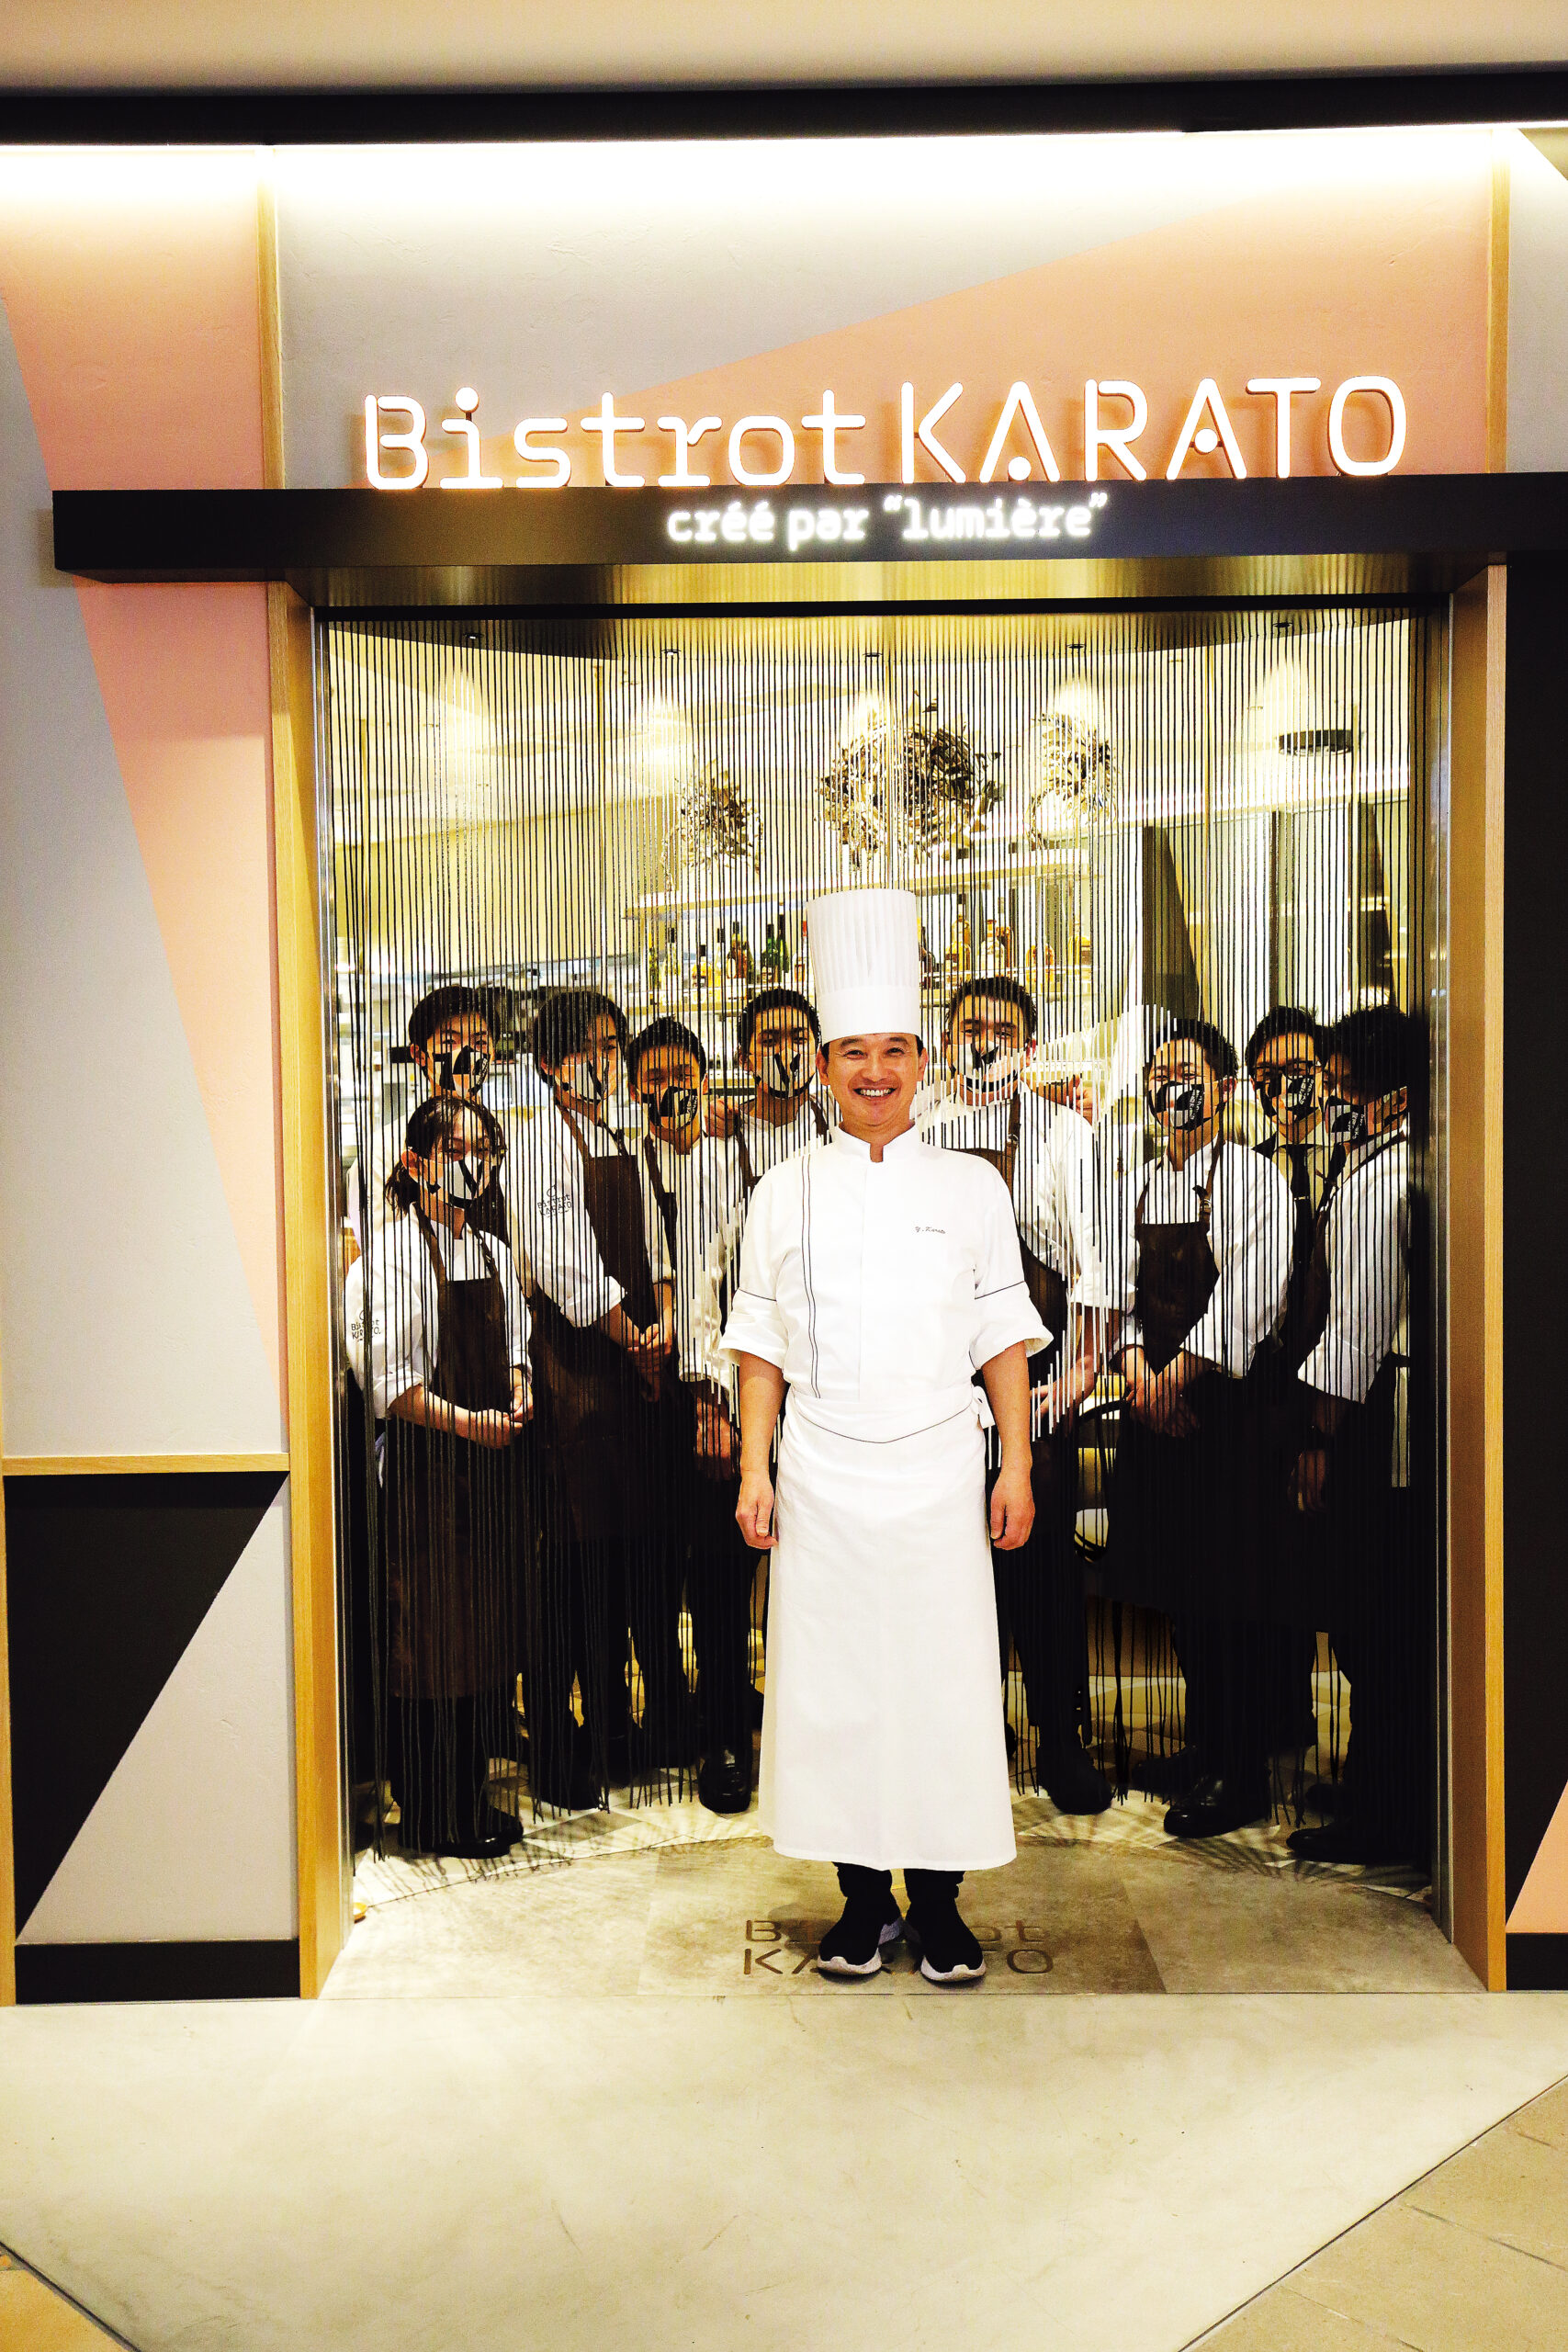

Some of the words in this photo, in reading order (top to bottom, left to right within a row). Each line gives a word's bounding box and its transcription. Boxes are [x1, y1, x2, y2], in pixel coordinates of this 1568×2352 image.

[365, 386, 867, 490] Bistrot
[900, 376, 1407, 484] KARATO
[666, 499, 777, 544] créé
[784, 506, 871, 552] par
